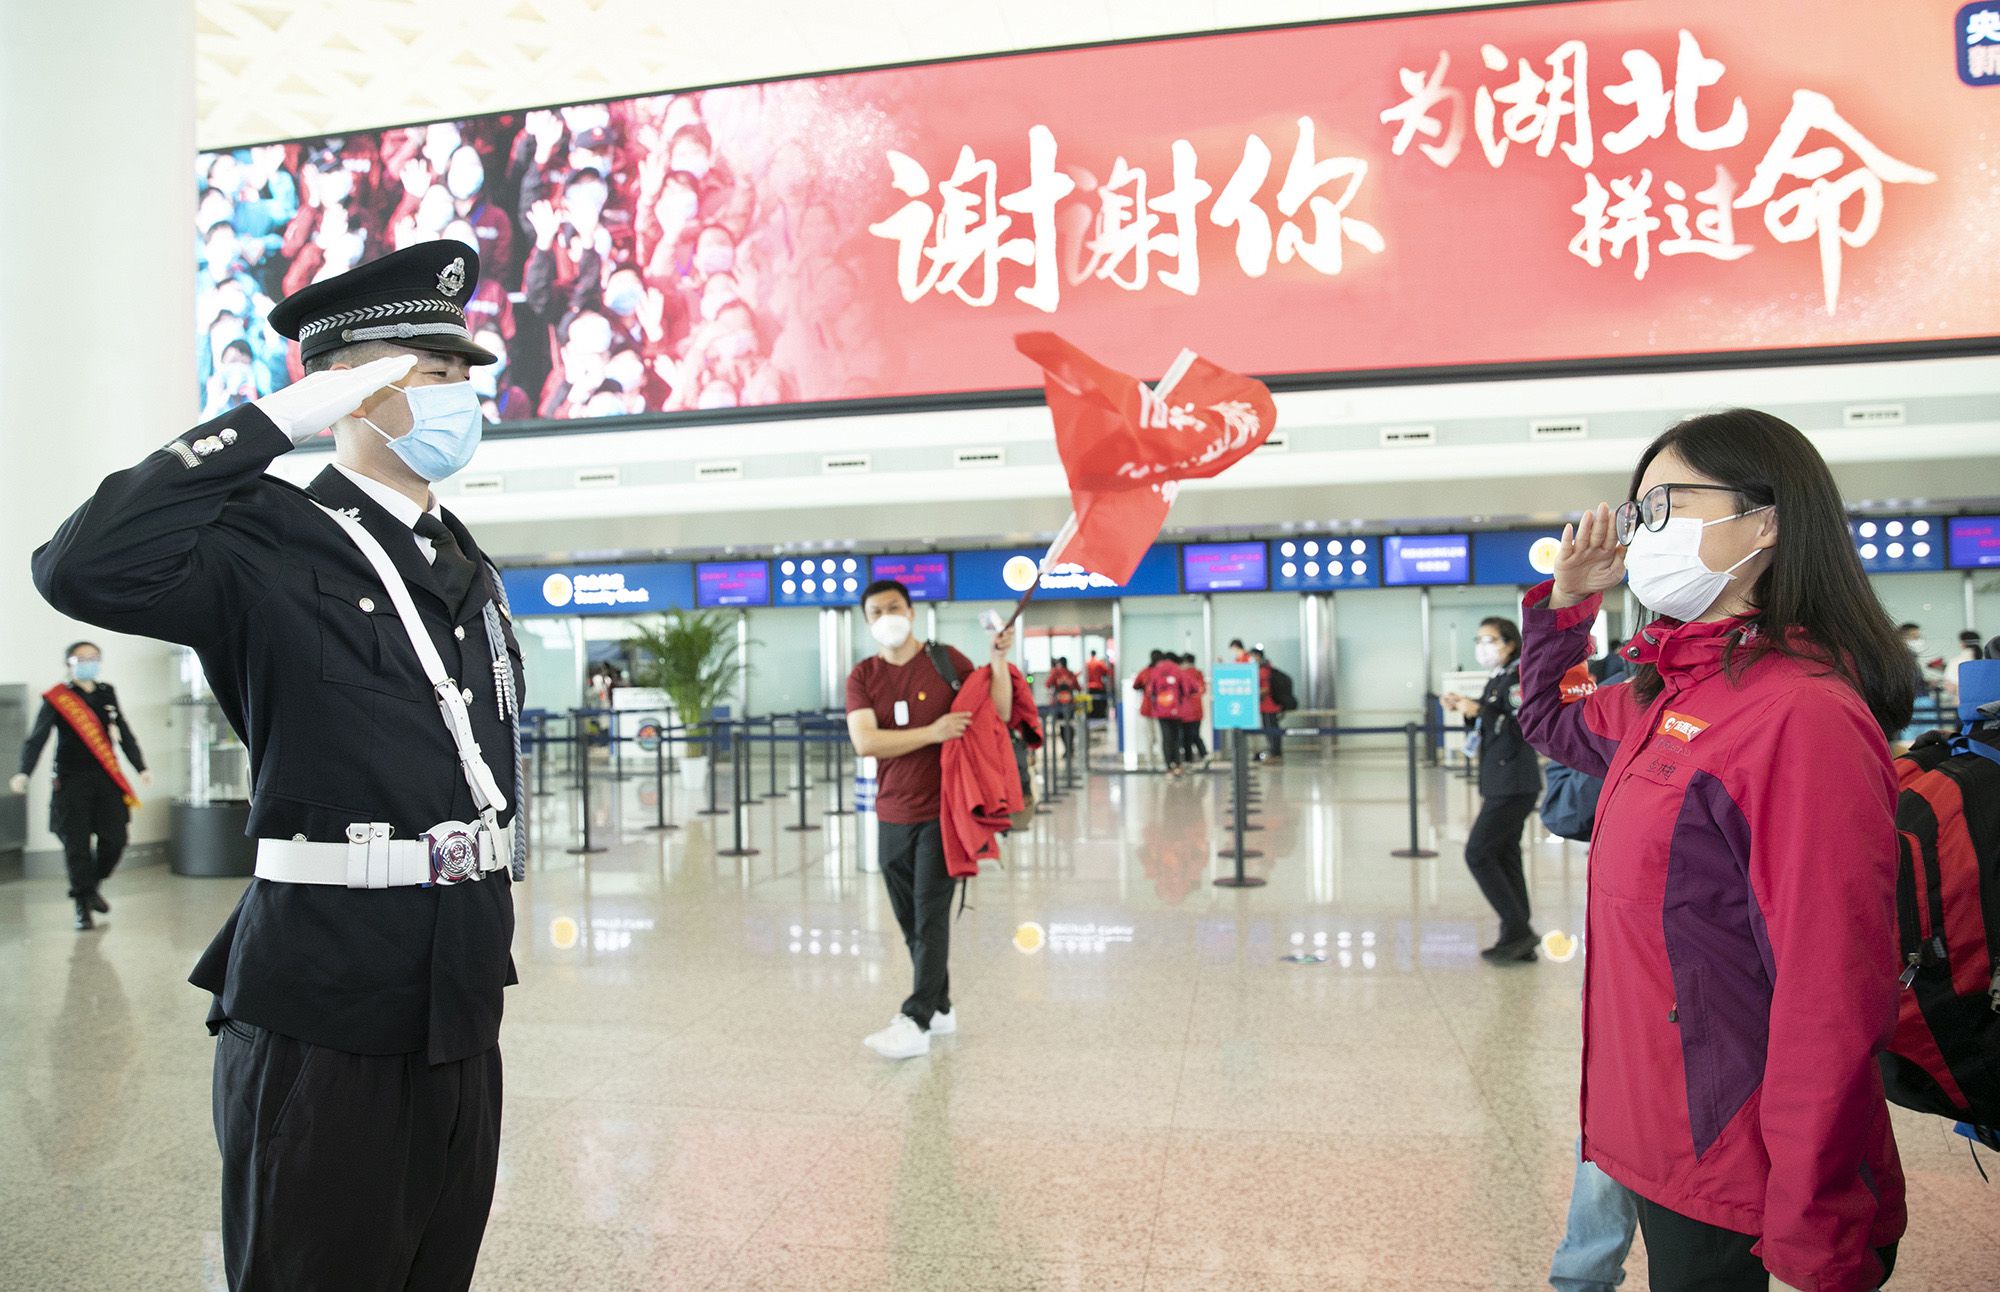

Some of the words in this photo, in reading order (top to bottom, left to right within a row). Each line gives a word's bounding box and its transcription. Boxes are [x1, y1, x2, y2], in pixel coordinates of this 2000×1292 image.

[1380, 28, 1748, 168] 为湖北
[869, 115, 1386, 313] 谢谢你
[1568, 88, 1938, 317] 拼过命
